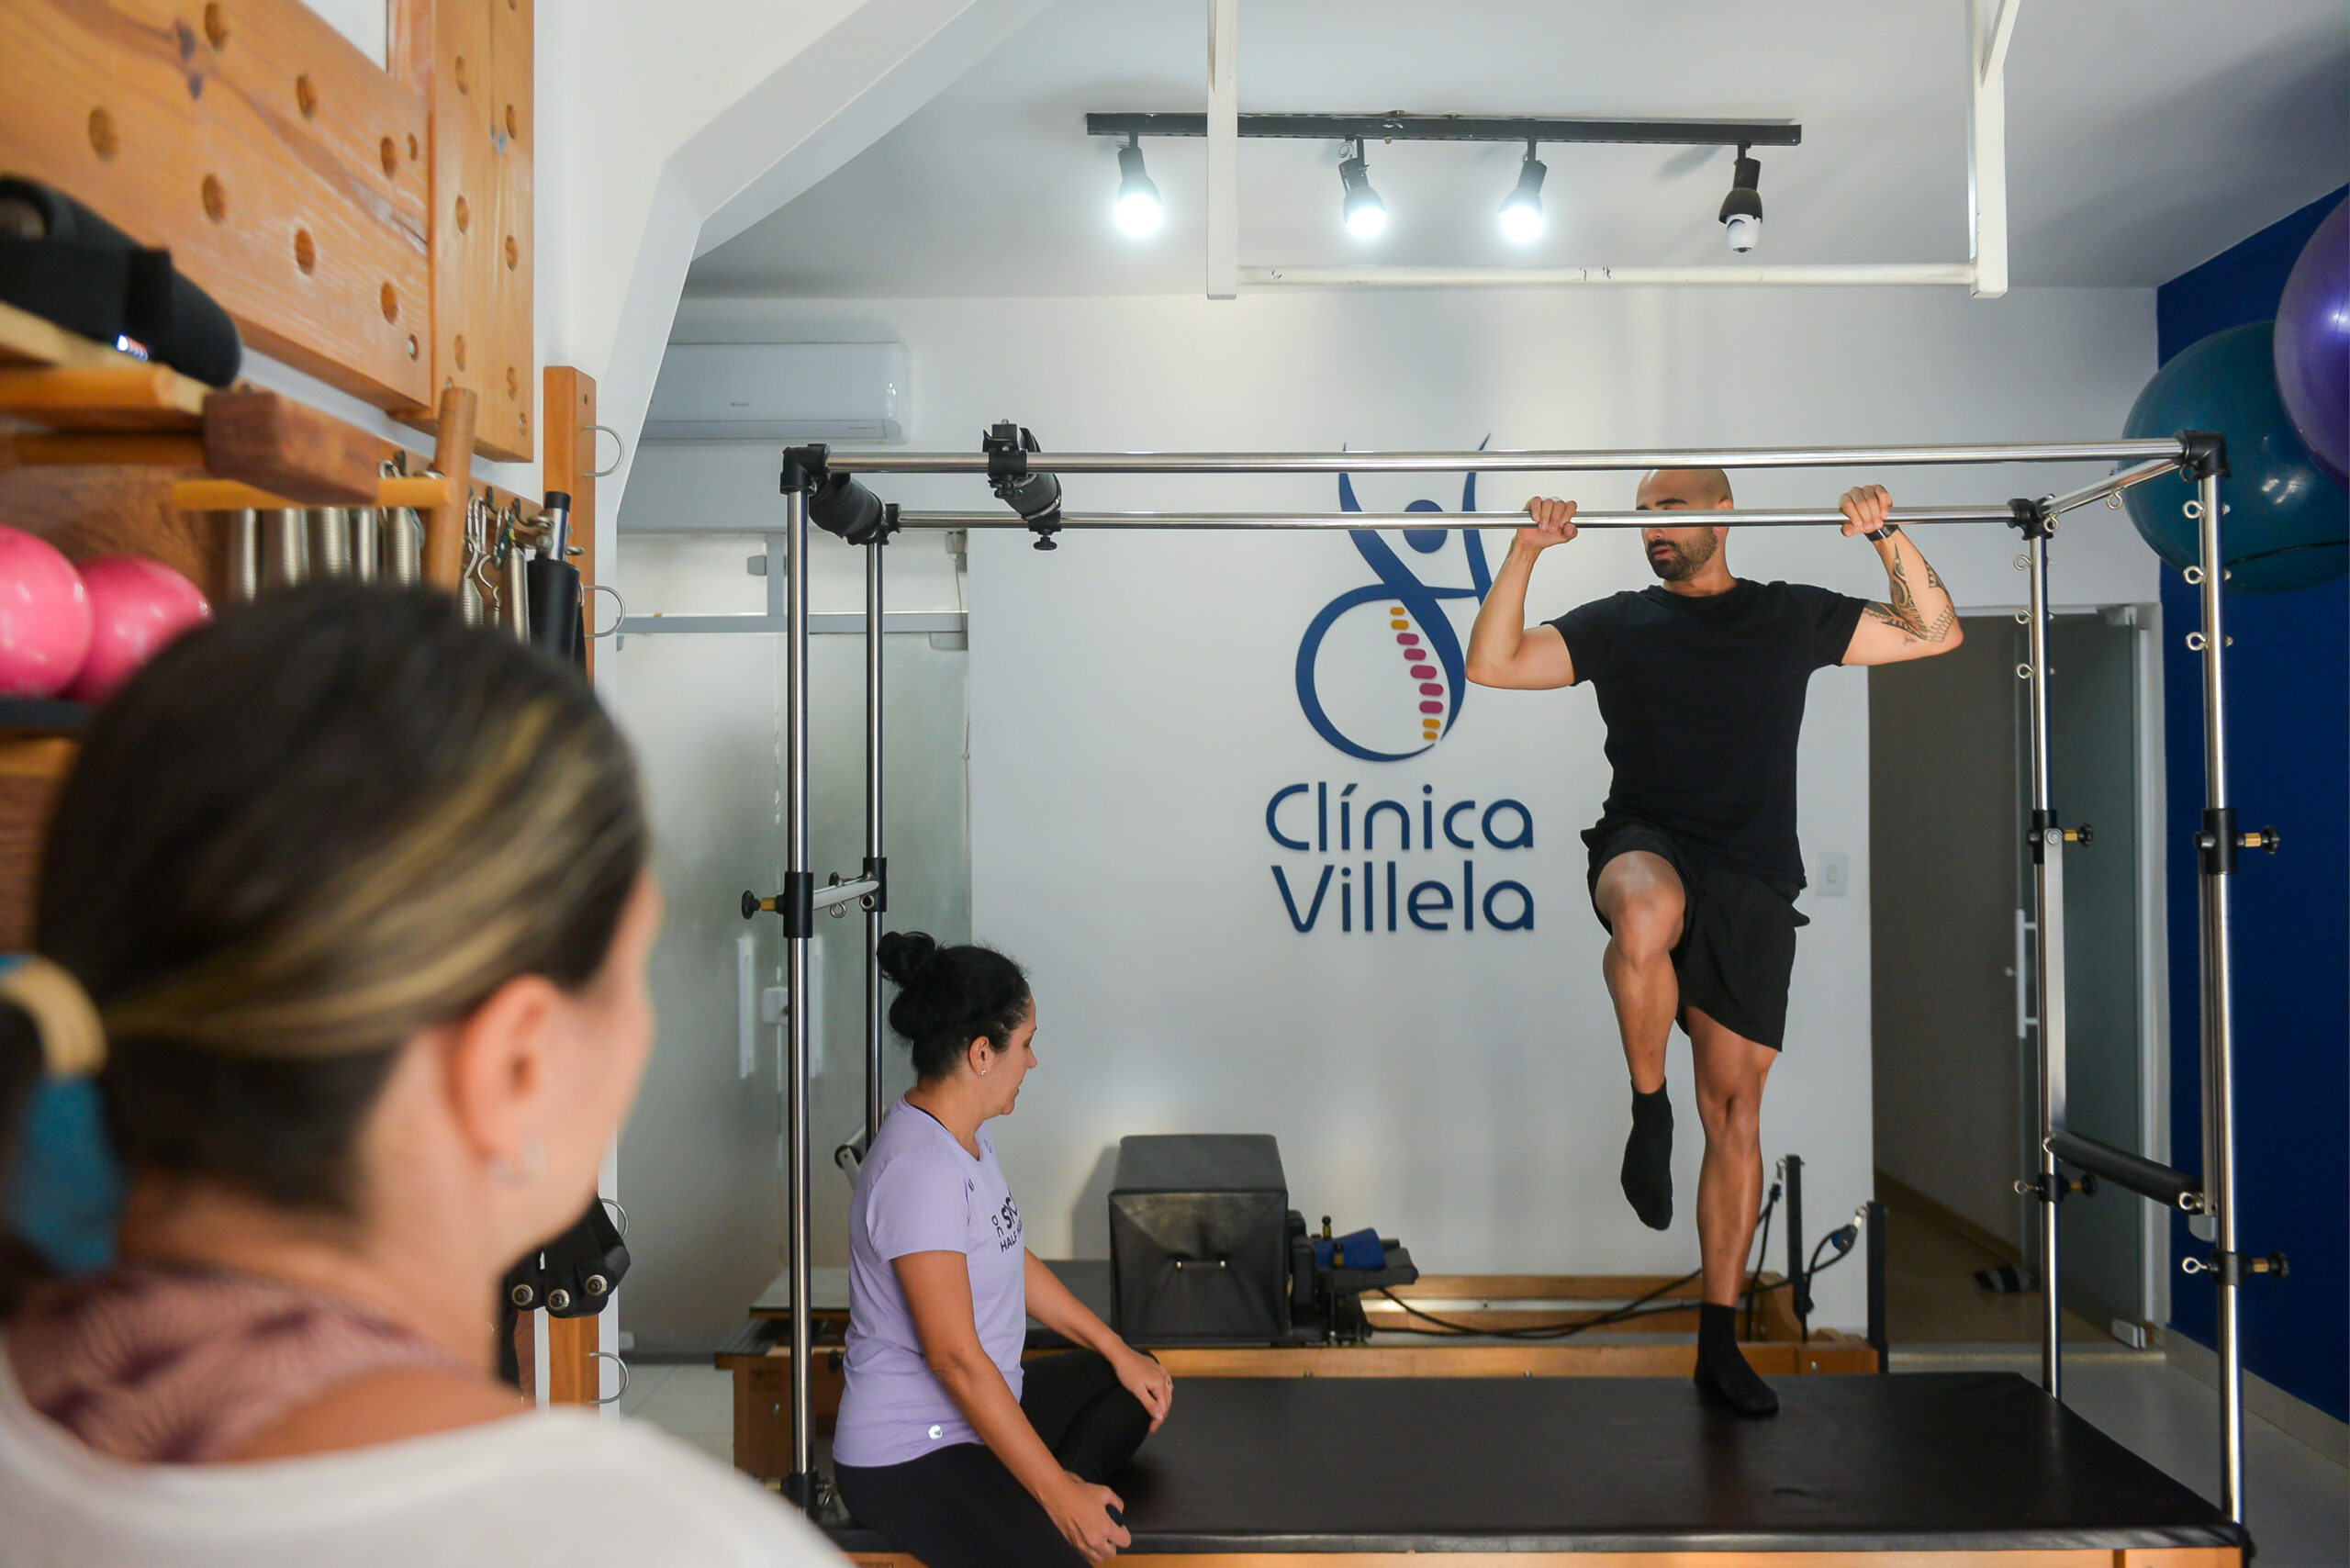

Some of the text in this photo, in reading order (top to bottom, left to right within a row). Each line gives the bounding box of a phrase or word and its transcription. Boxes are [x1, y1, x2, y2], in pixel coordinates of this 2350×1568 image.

[1266, 781, 1534, 852] Clínica
[1270, 859, 1534, 933] Villela
[1000, 1229, 1017, 1253] HALF
